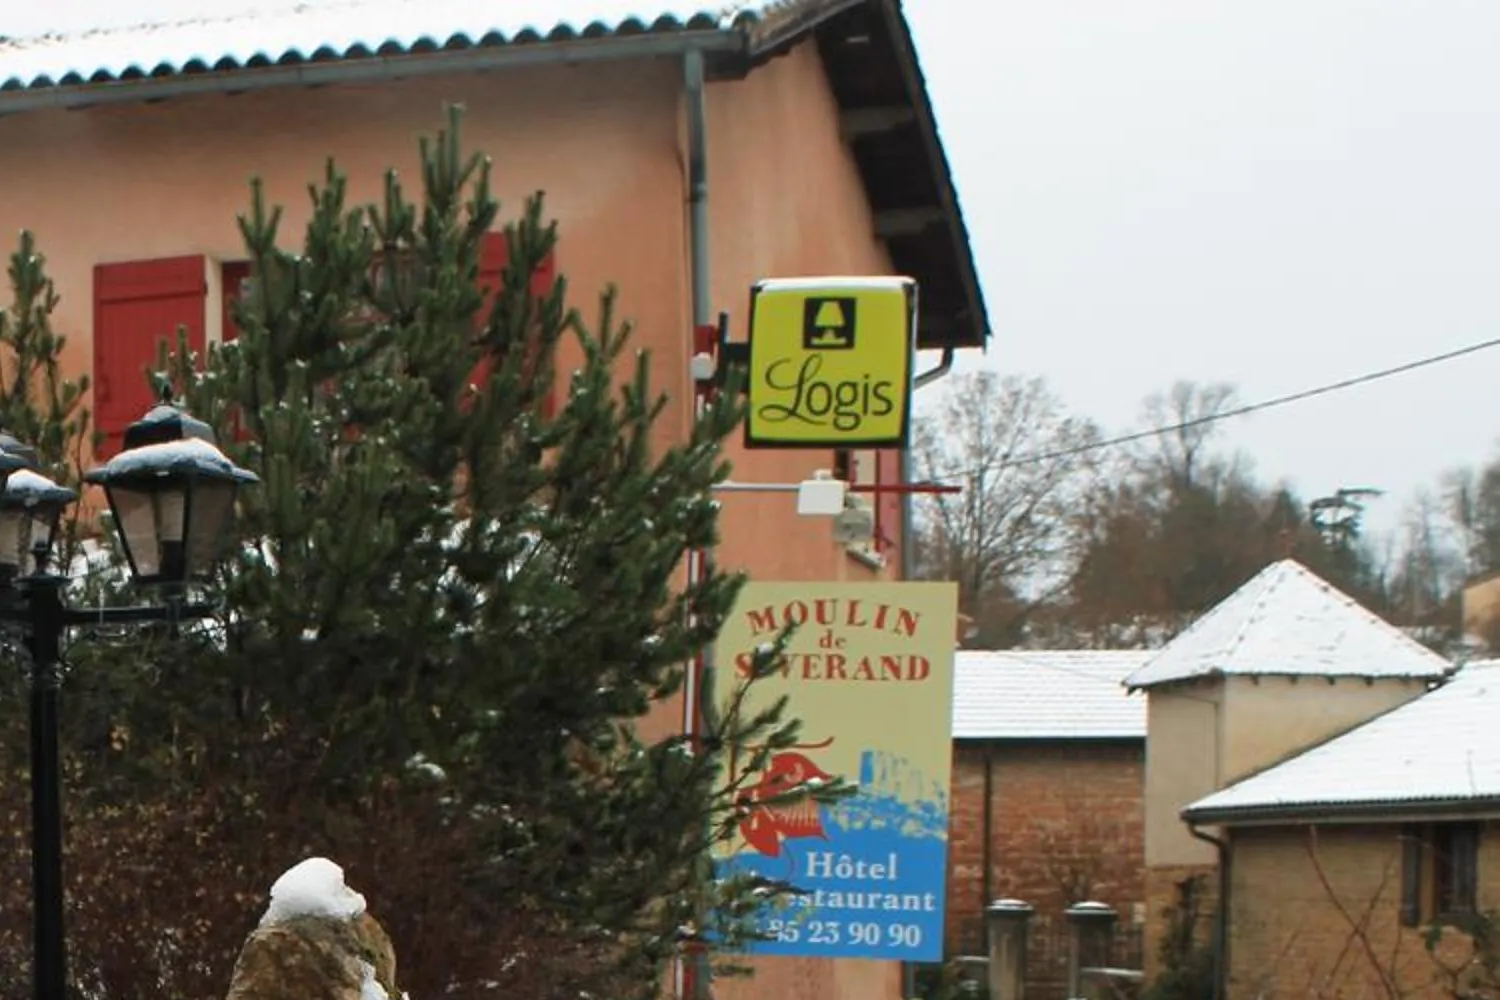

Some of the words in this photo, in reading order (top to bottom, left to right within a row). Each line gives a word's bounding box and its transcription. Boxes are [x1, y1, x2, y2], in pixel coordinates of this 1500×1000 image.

[757, 353, 894, 432] Logis
[745, 598, 921, 638] MOULIN
[819, 629, 846, 650] de
[806, 851, 899, 880] Hôtel
[807, 920, 841, 944] 23
[848, 921, 881, 946] 90
[887, 923, 921, 948] 90
